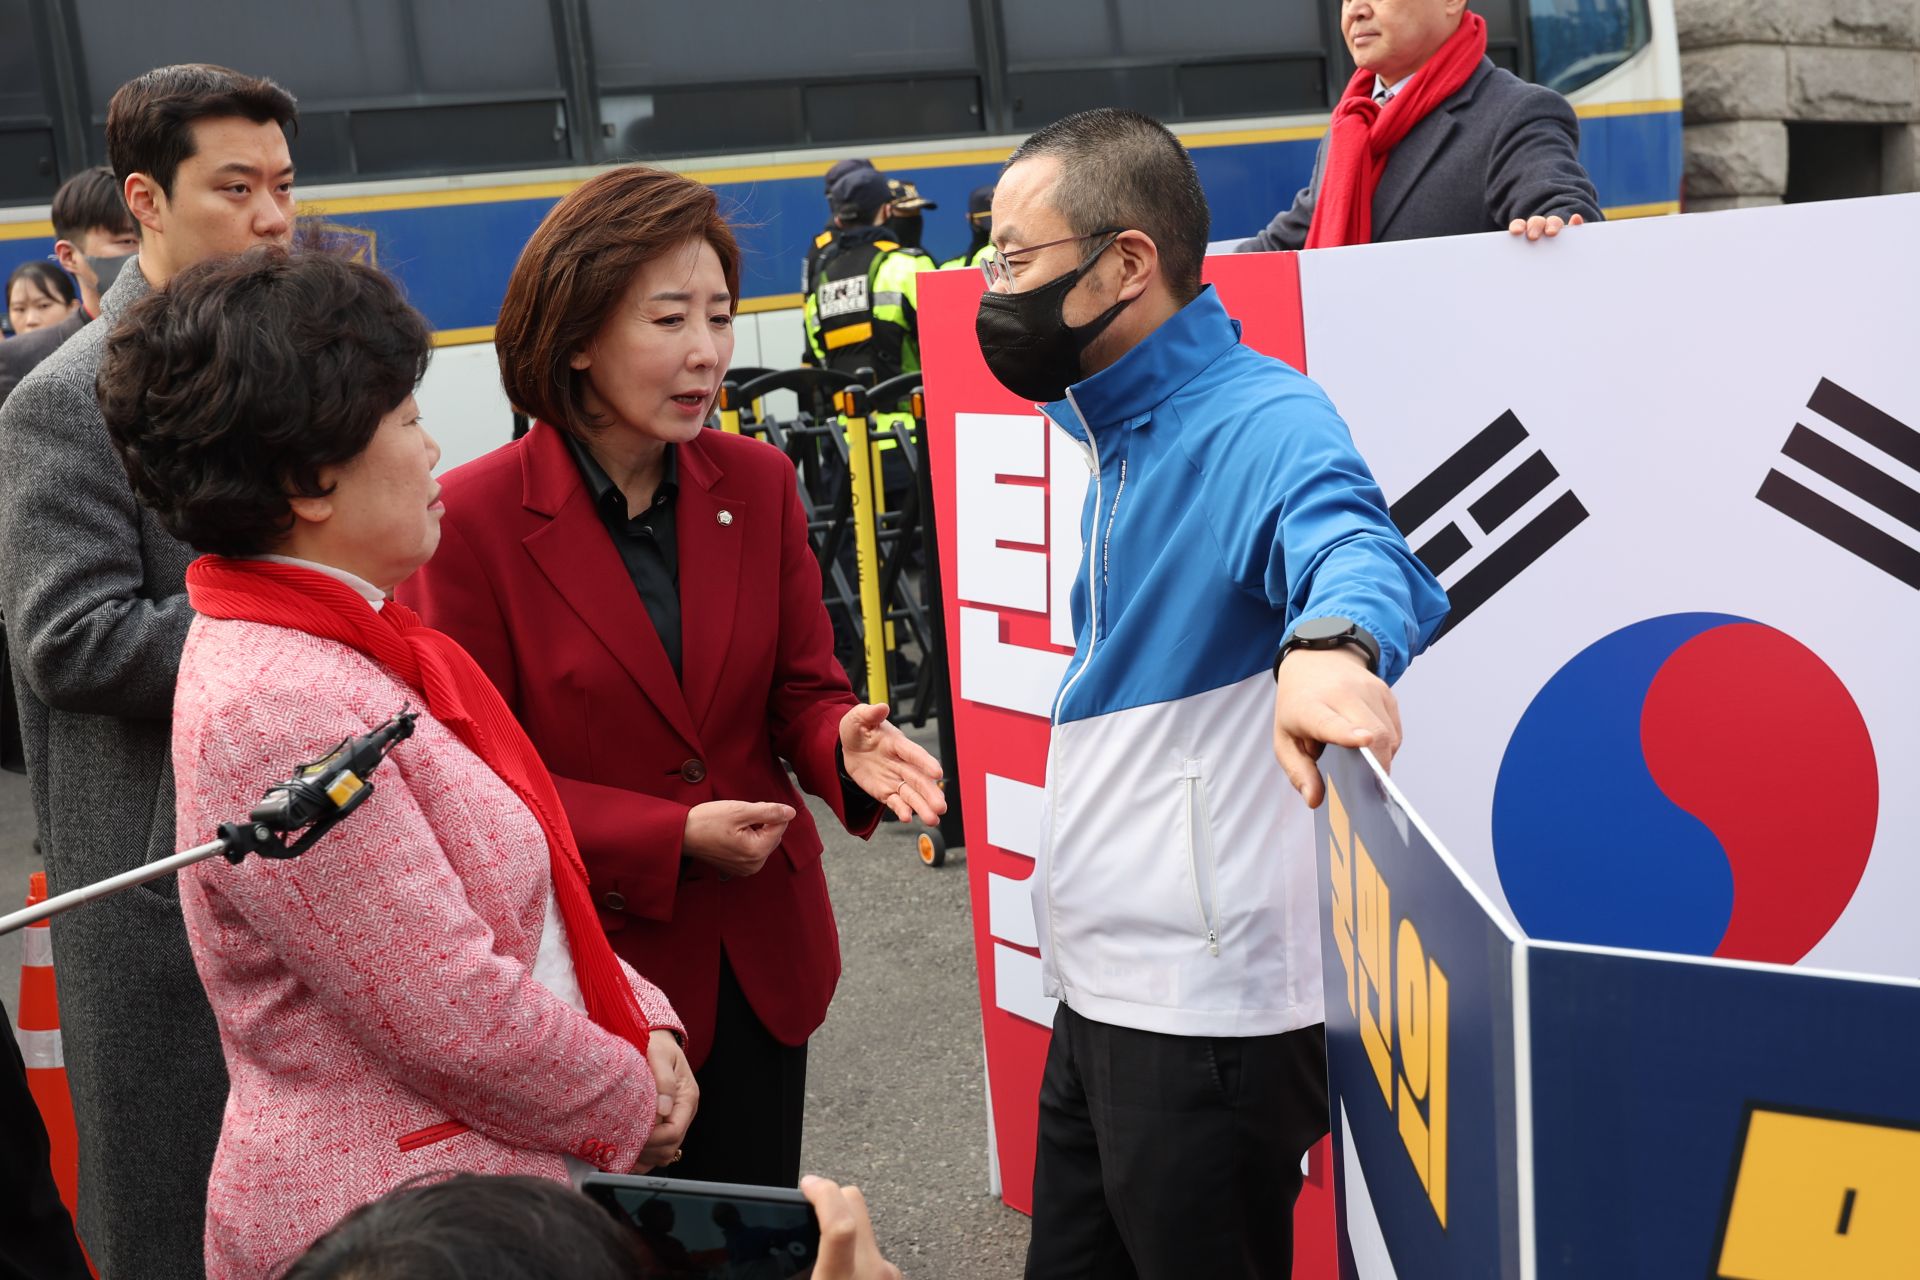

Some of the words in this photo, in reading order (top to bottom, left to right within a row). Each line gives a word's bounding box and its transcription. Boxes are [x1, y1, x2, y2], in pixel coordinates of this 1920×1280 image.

[1111, 460, 1127, 516] PERFORMANCE
[1104, 517, 1114, 572] SPORTSWEAR
[1327, 773, 1449, 1231] 국민의
